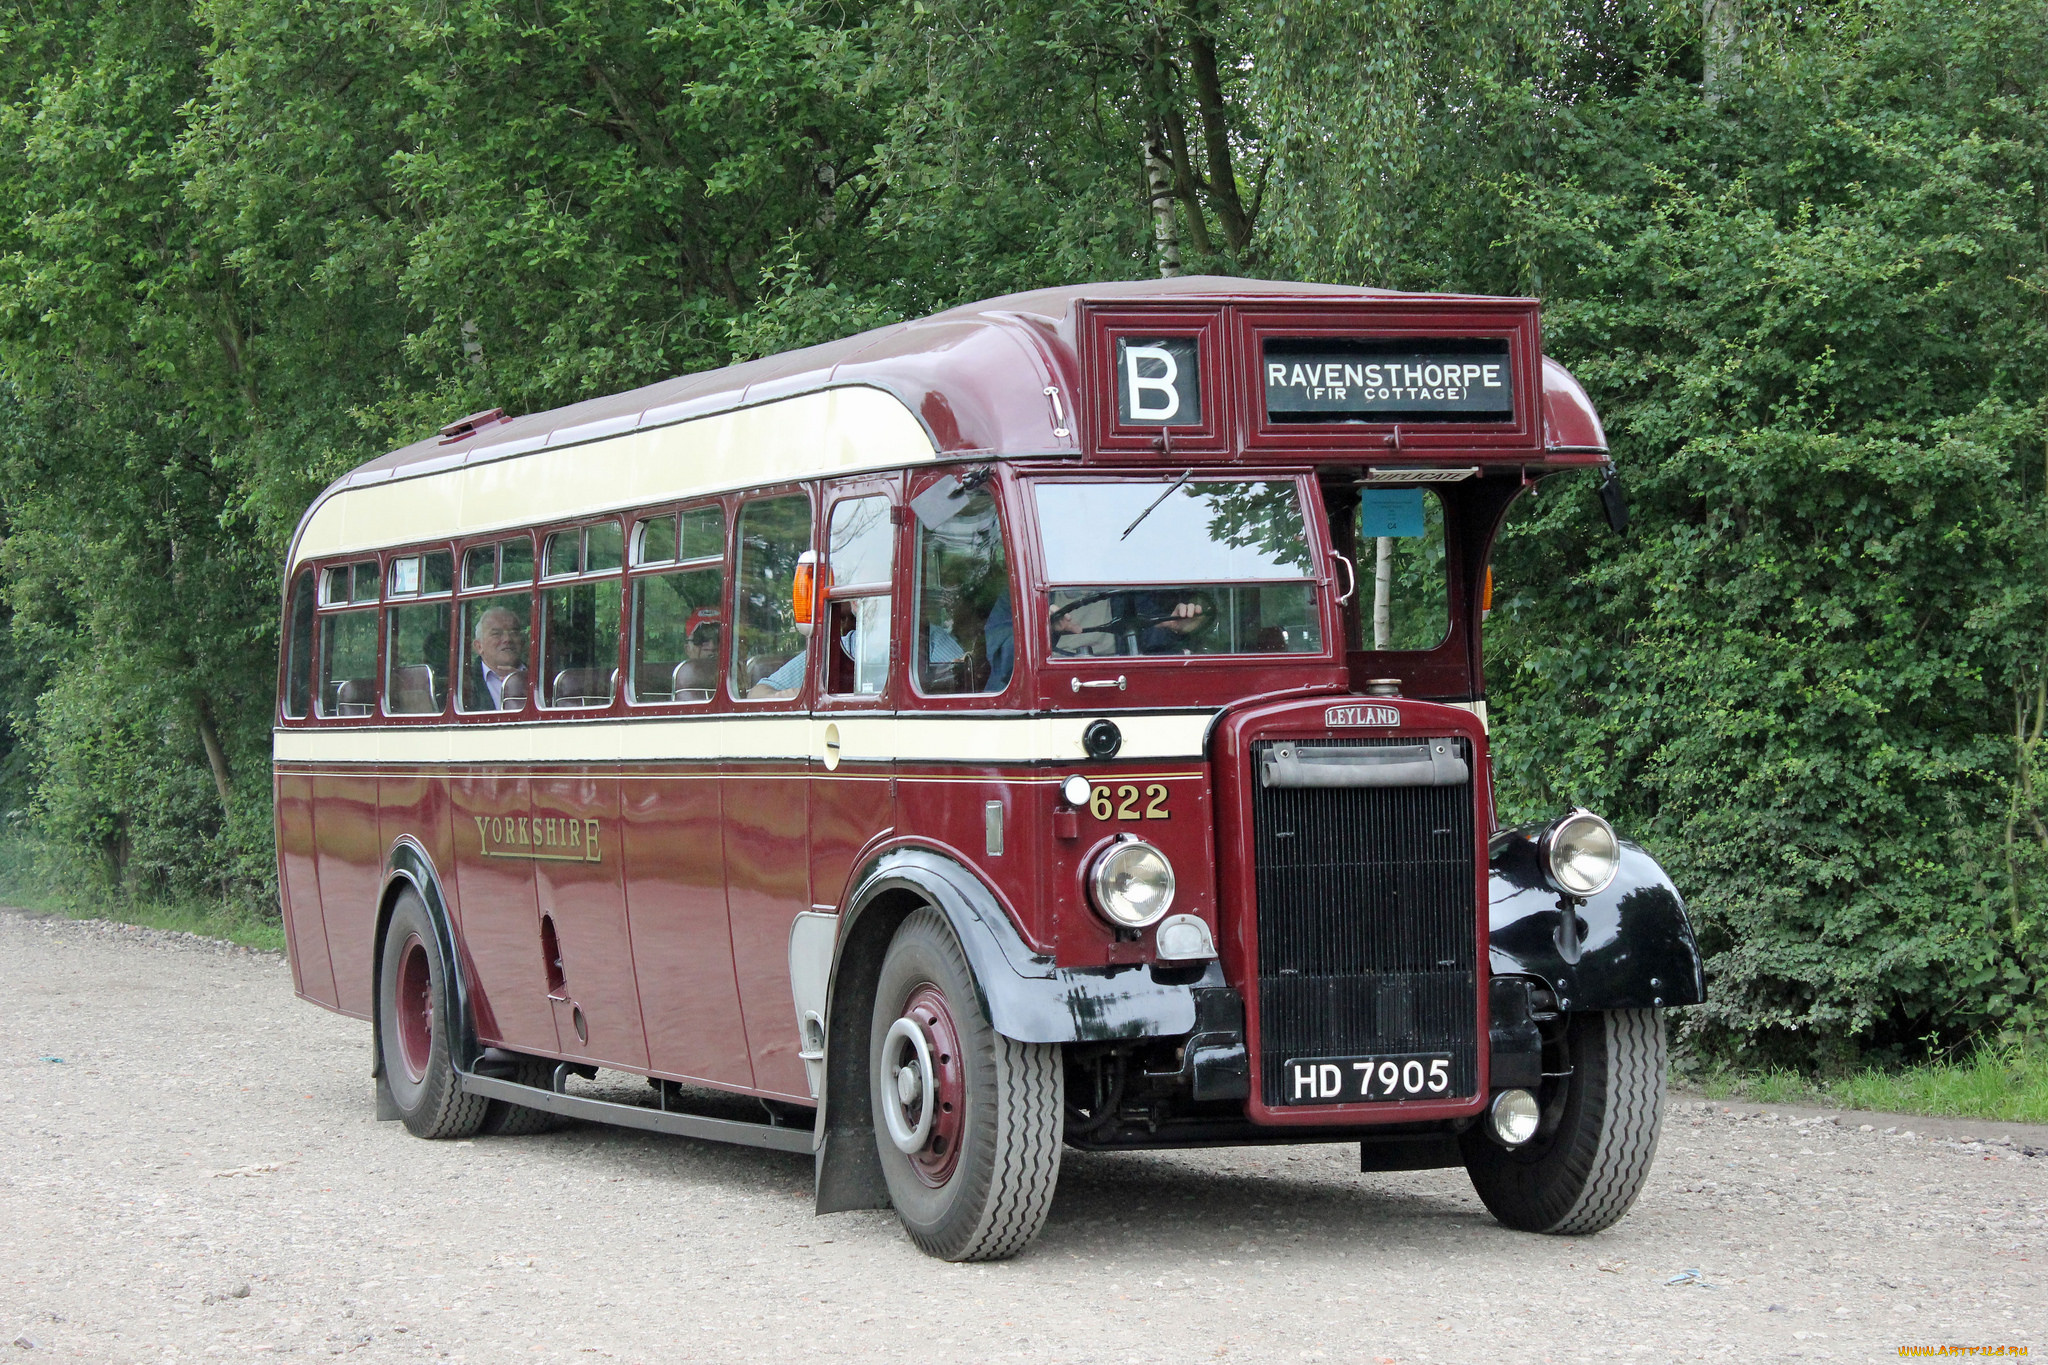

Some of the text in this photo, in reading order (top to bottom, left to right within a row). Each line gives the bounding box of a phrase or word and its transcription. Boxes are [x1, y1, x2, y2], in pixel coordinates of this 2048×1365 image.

[1125, 346, 1180, 420] B
[1268, 363, 1502, 387] RAVENSTHORPE
[1306, 387, 1468, 400] (FIR COTTAGE)
[1328, 707, 1398, 725] LEYLAND
[1089, 783, 1171, 821] 622
[474, 816, 601, 862] YORKSHIRE
[1294, 1059, 1449, 1099] HD 7905
